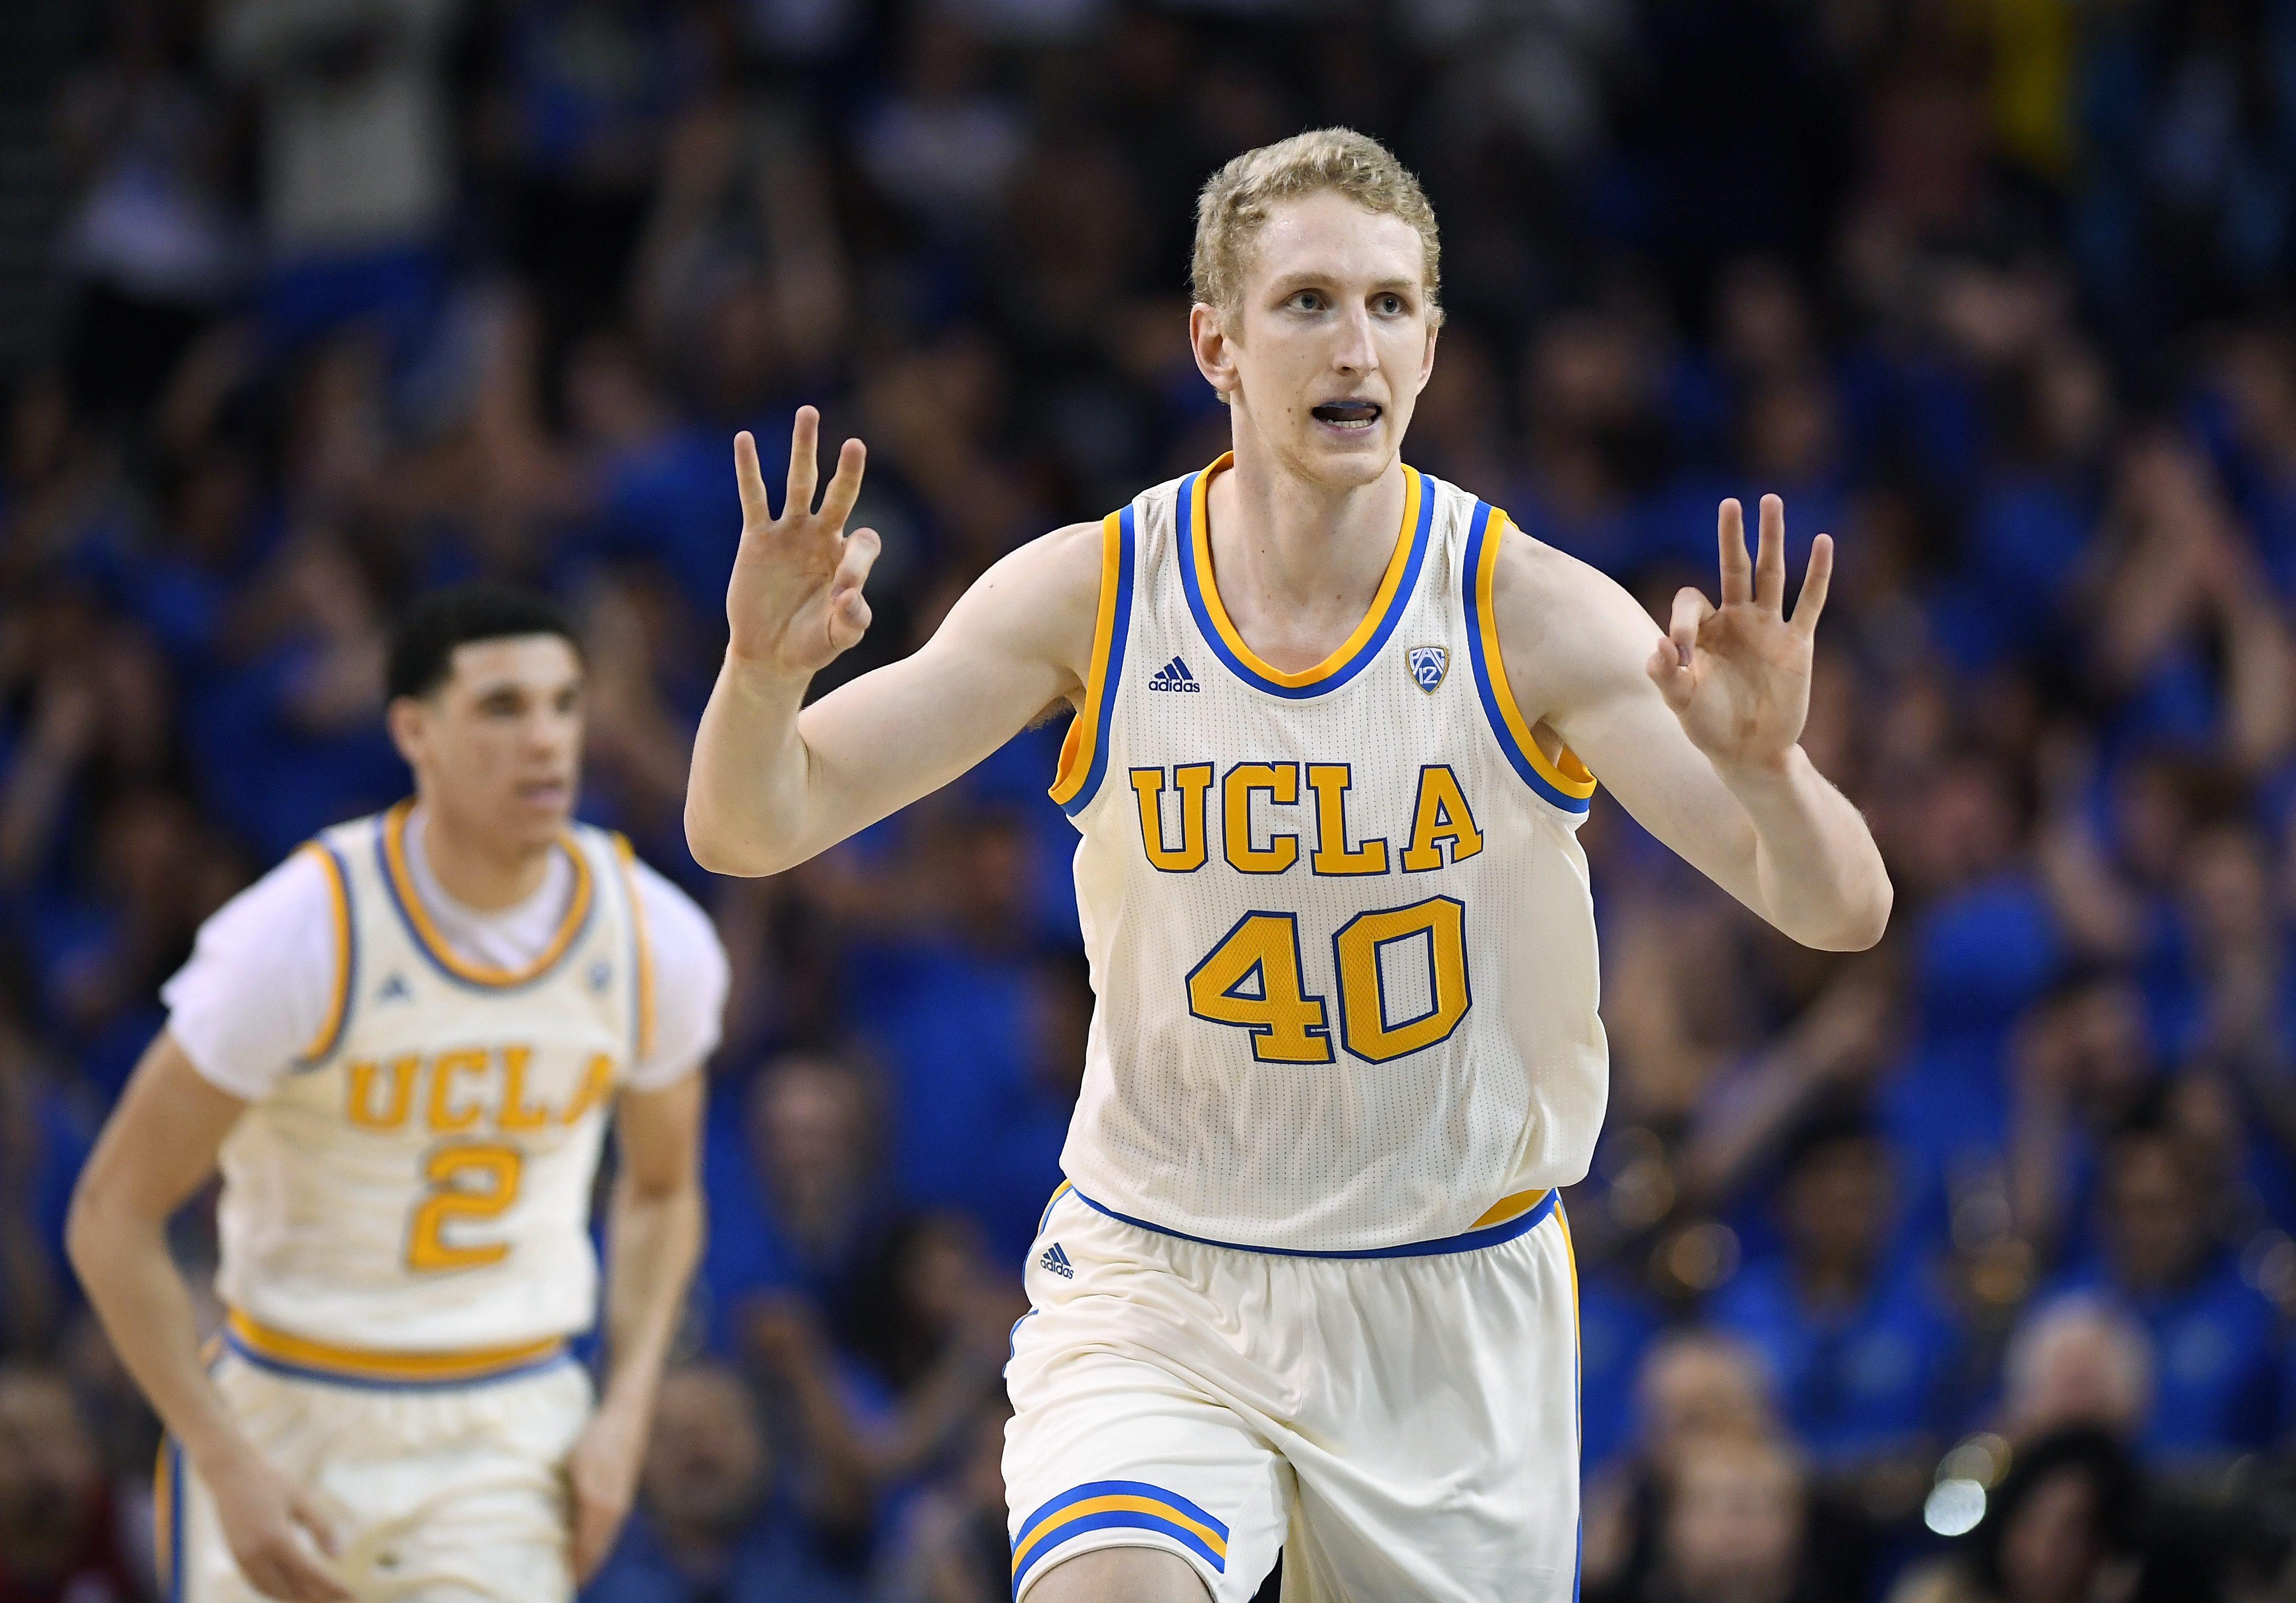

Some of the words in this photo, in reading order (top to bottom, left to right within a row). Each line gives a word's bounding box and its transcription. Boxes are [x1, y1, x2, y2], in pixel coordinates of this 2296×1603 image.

[1409, 647, 1445, 676] PAC
[1419, 666, 1437, 684] 12
[1149, 679, 1200, 693] adidas
[1129, 761, 1483, 876] UCLA
[1185, 894, 1472, 1065] 40
[406, 1141, 525, 1273] 2
[1041, 1258, 1074, 1279] adidas
